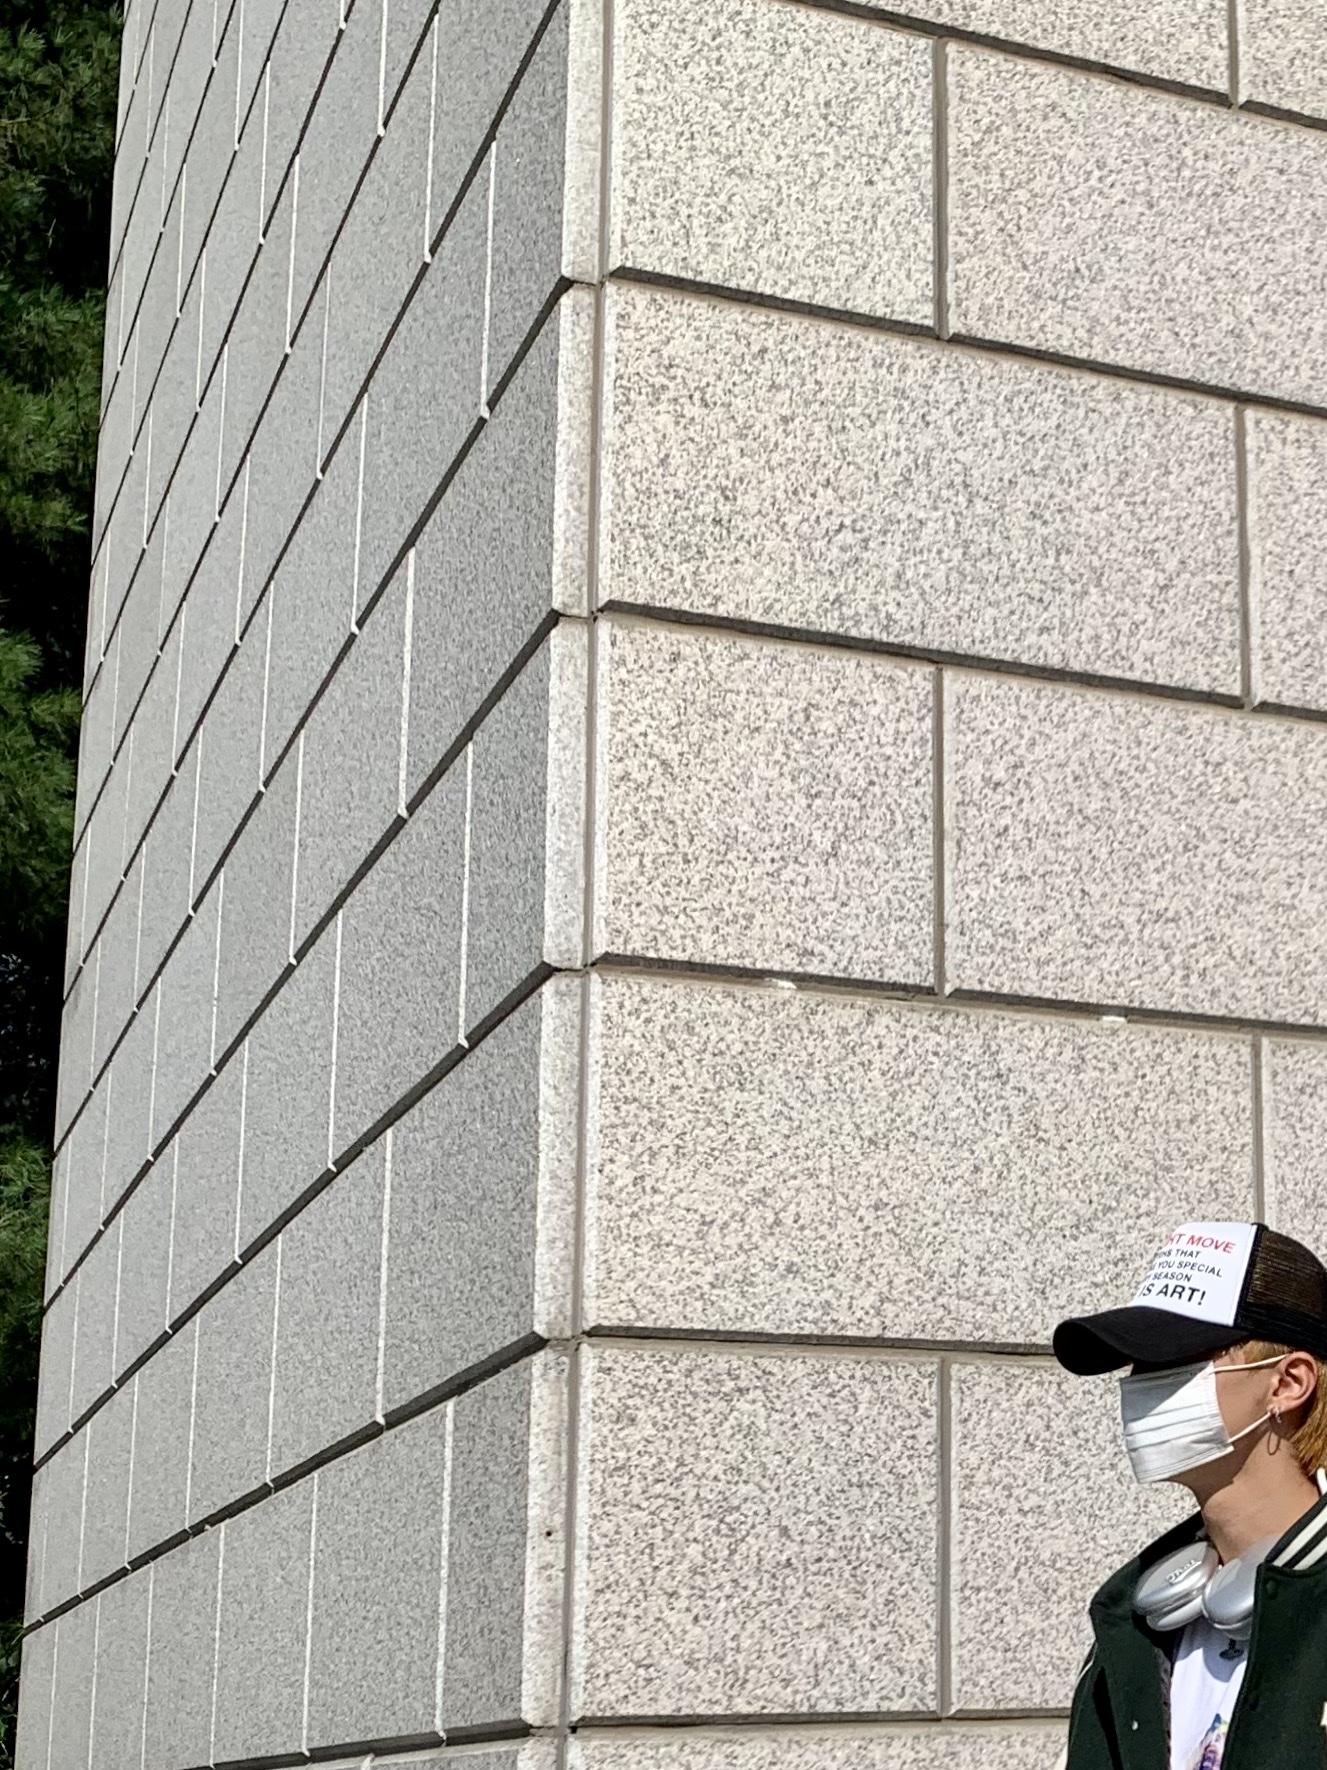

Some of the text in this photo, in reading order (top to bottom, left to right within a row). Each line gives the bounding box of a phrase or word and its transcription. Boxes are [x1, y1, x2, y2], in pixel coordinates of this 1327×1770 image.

[1186, 1234, 1236, 1254] MOVE
[1175, 1248, 1201, 1259] THAT
[1152, 1271, 1192, 1282] SEASON
[1158, 1260, 1175, 1269] YOU
[1176, 1260, 1222, 1278] SPECIAL
[1156, 1283, 1206, 1306] ART!
